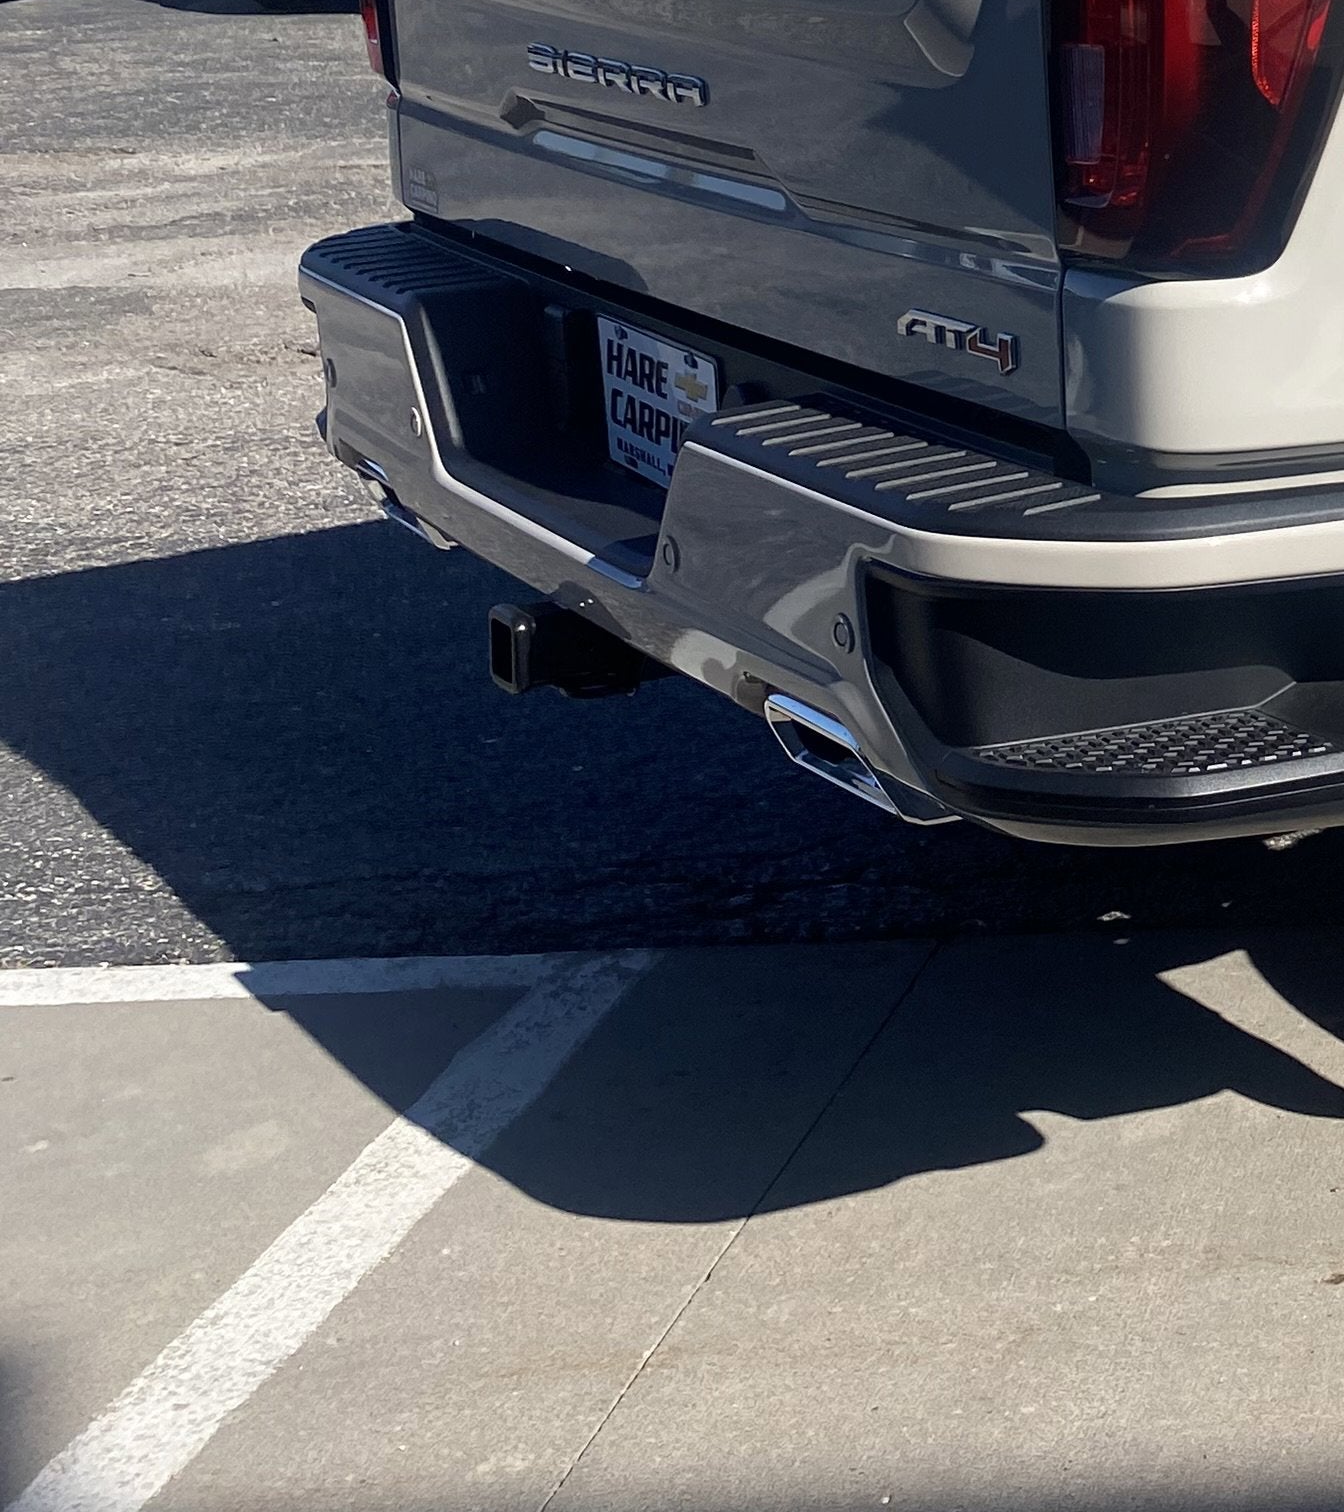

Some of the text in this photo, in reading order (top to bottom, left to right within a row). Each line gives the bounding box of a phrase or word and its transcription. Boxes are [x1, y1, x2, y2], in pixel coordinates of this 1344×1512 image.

[526, 42, 711, 108] SIERRA
[606, 338, 669, 400] HARE
[896, 307, 1021, 376] AT4
[610, 387, 687, 454] CARPI
